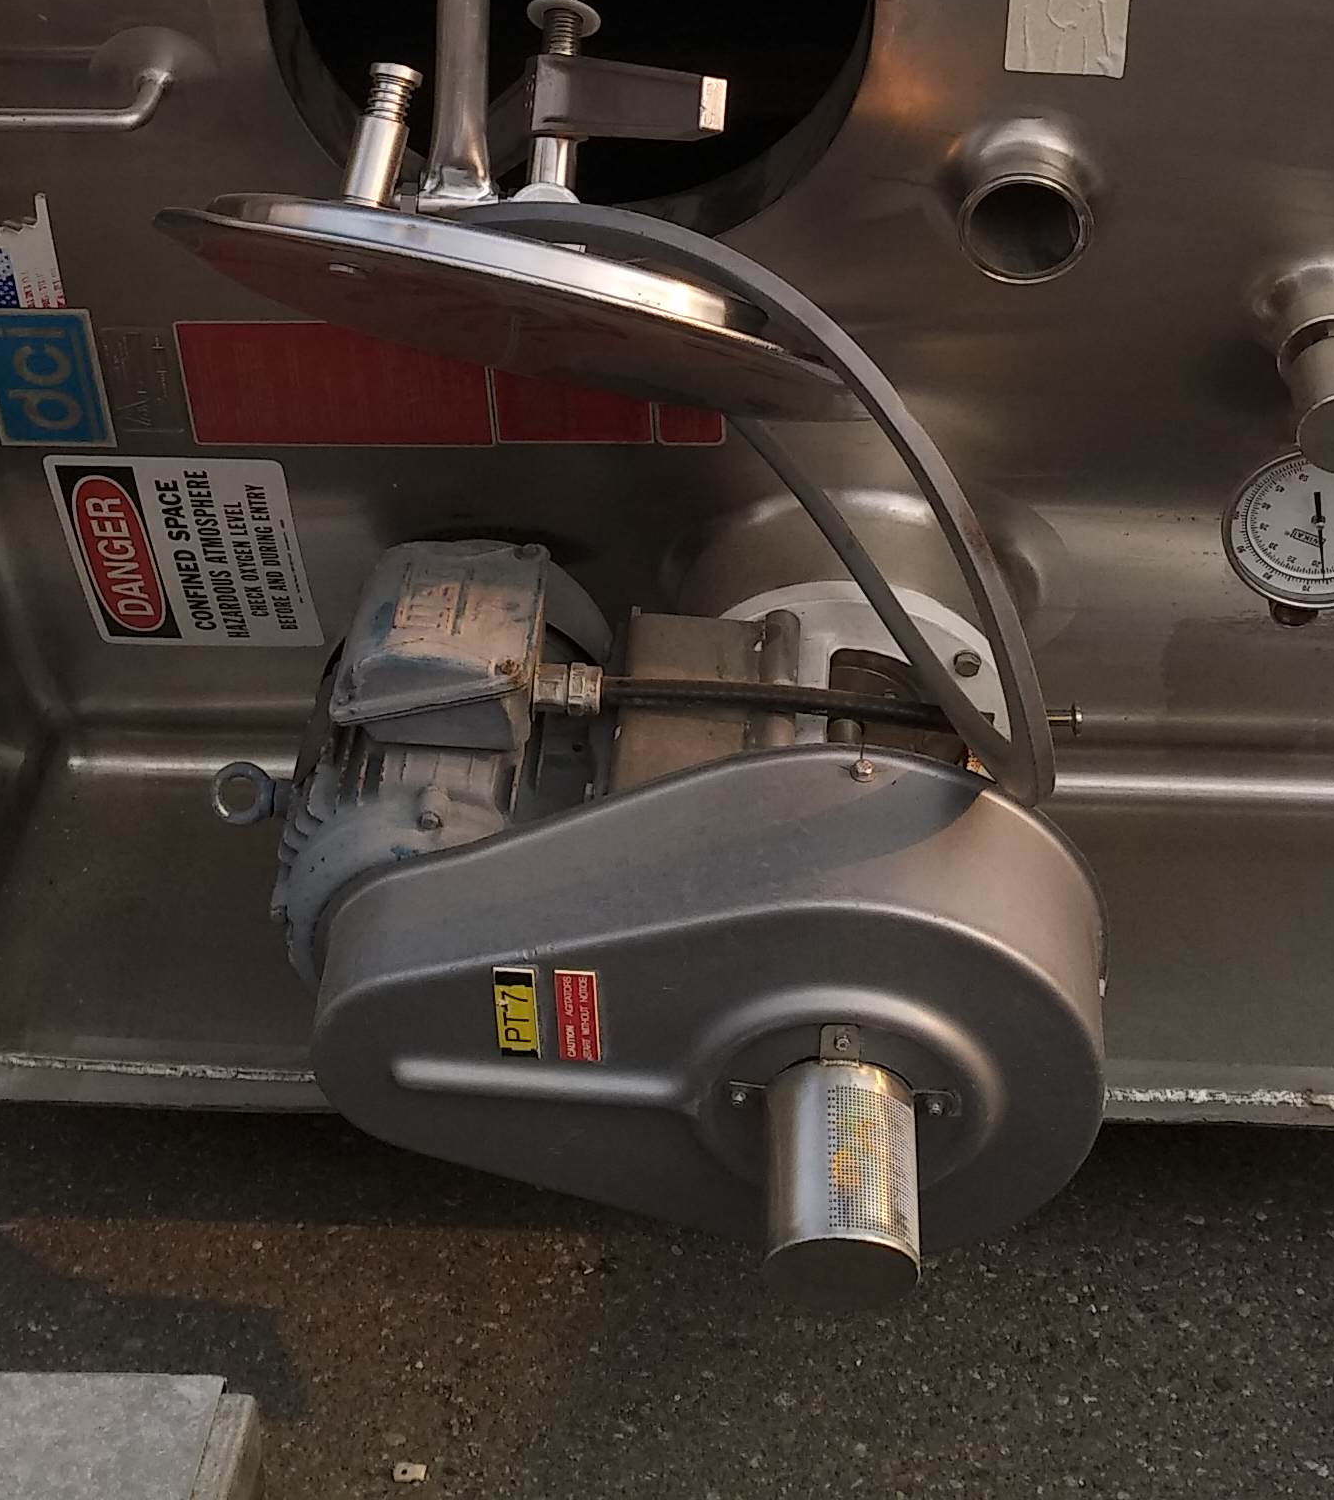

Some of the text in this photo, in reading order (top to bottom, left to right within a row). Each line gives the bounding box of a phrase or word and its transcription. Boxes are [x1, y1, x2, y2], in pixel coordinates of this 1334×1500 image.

[245, 484, 270, 521] ENTRY
[84, 497, 155, 616] DANGER
[155, 479, 216, 630] CONFINED SPACE
[184, 470, 250, 638] HAZARDOUS ATMOSPHERE
[223, 502, 269, 617] CHECK OXYGEN LEVEL
[255, 526, 279, 566] DURING
[267, 572, 287, 590] AND
[273, 596, 298, 630] BEFORE
[563, 976, 573, 1016] AGITATORS
[578, 976, 588, 1002] NOTICE
[501, 991, 531, 1042] PT 7
[579, 1005, 590, 1035] WITHOUT
[565, 1025, 576, 1058] CAUTION
